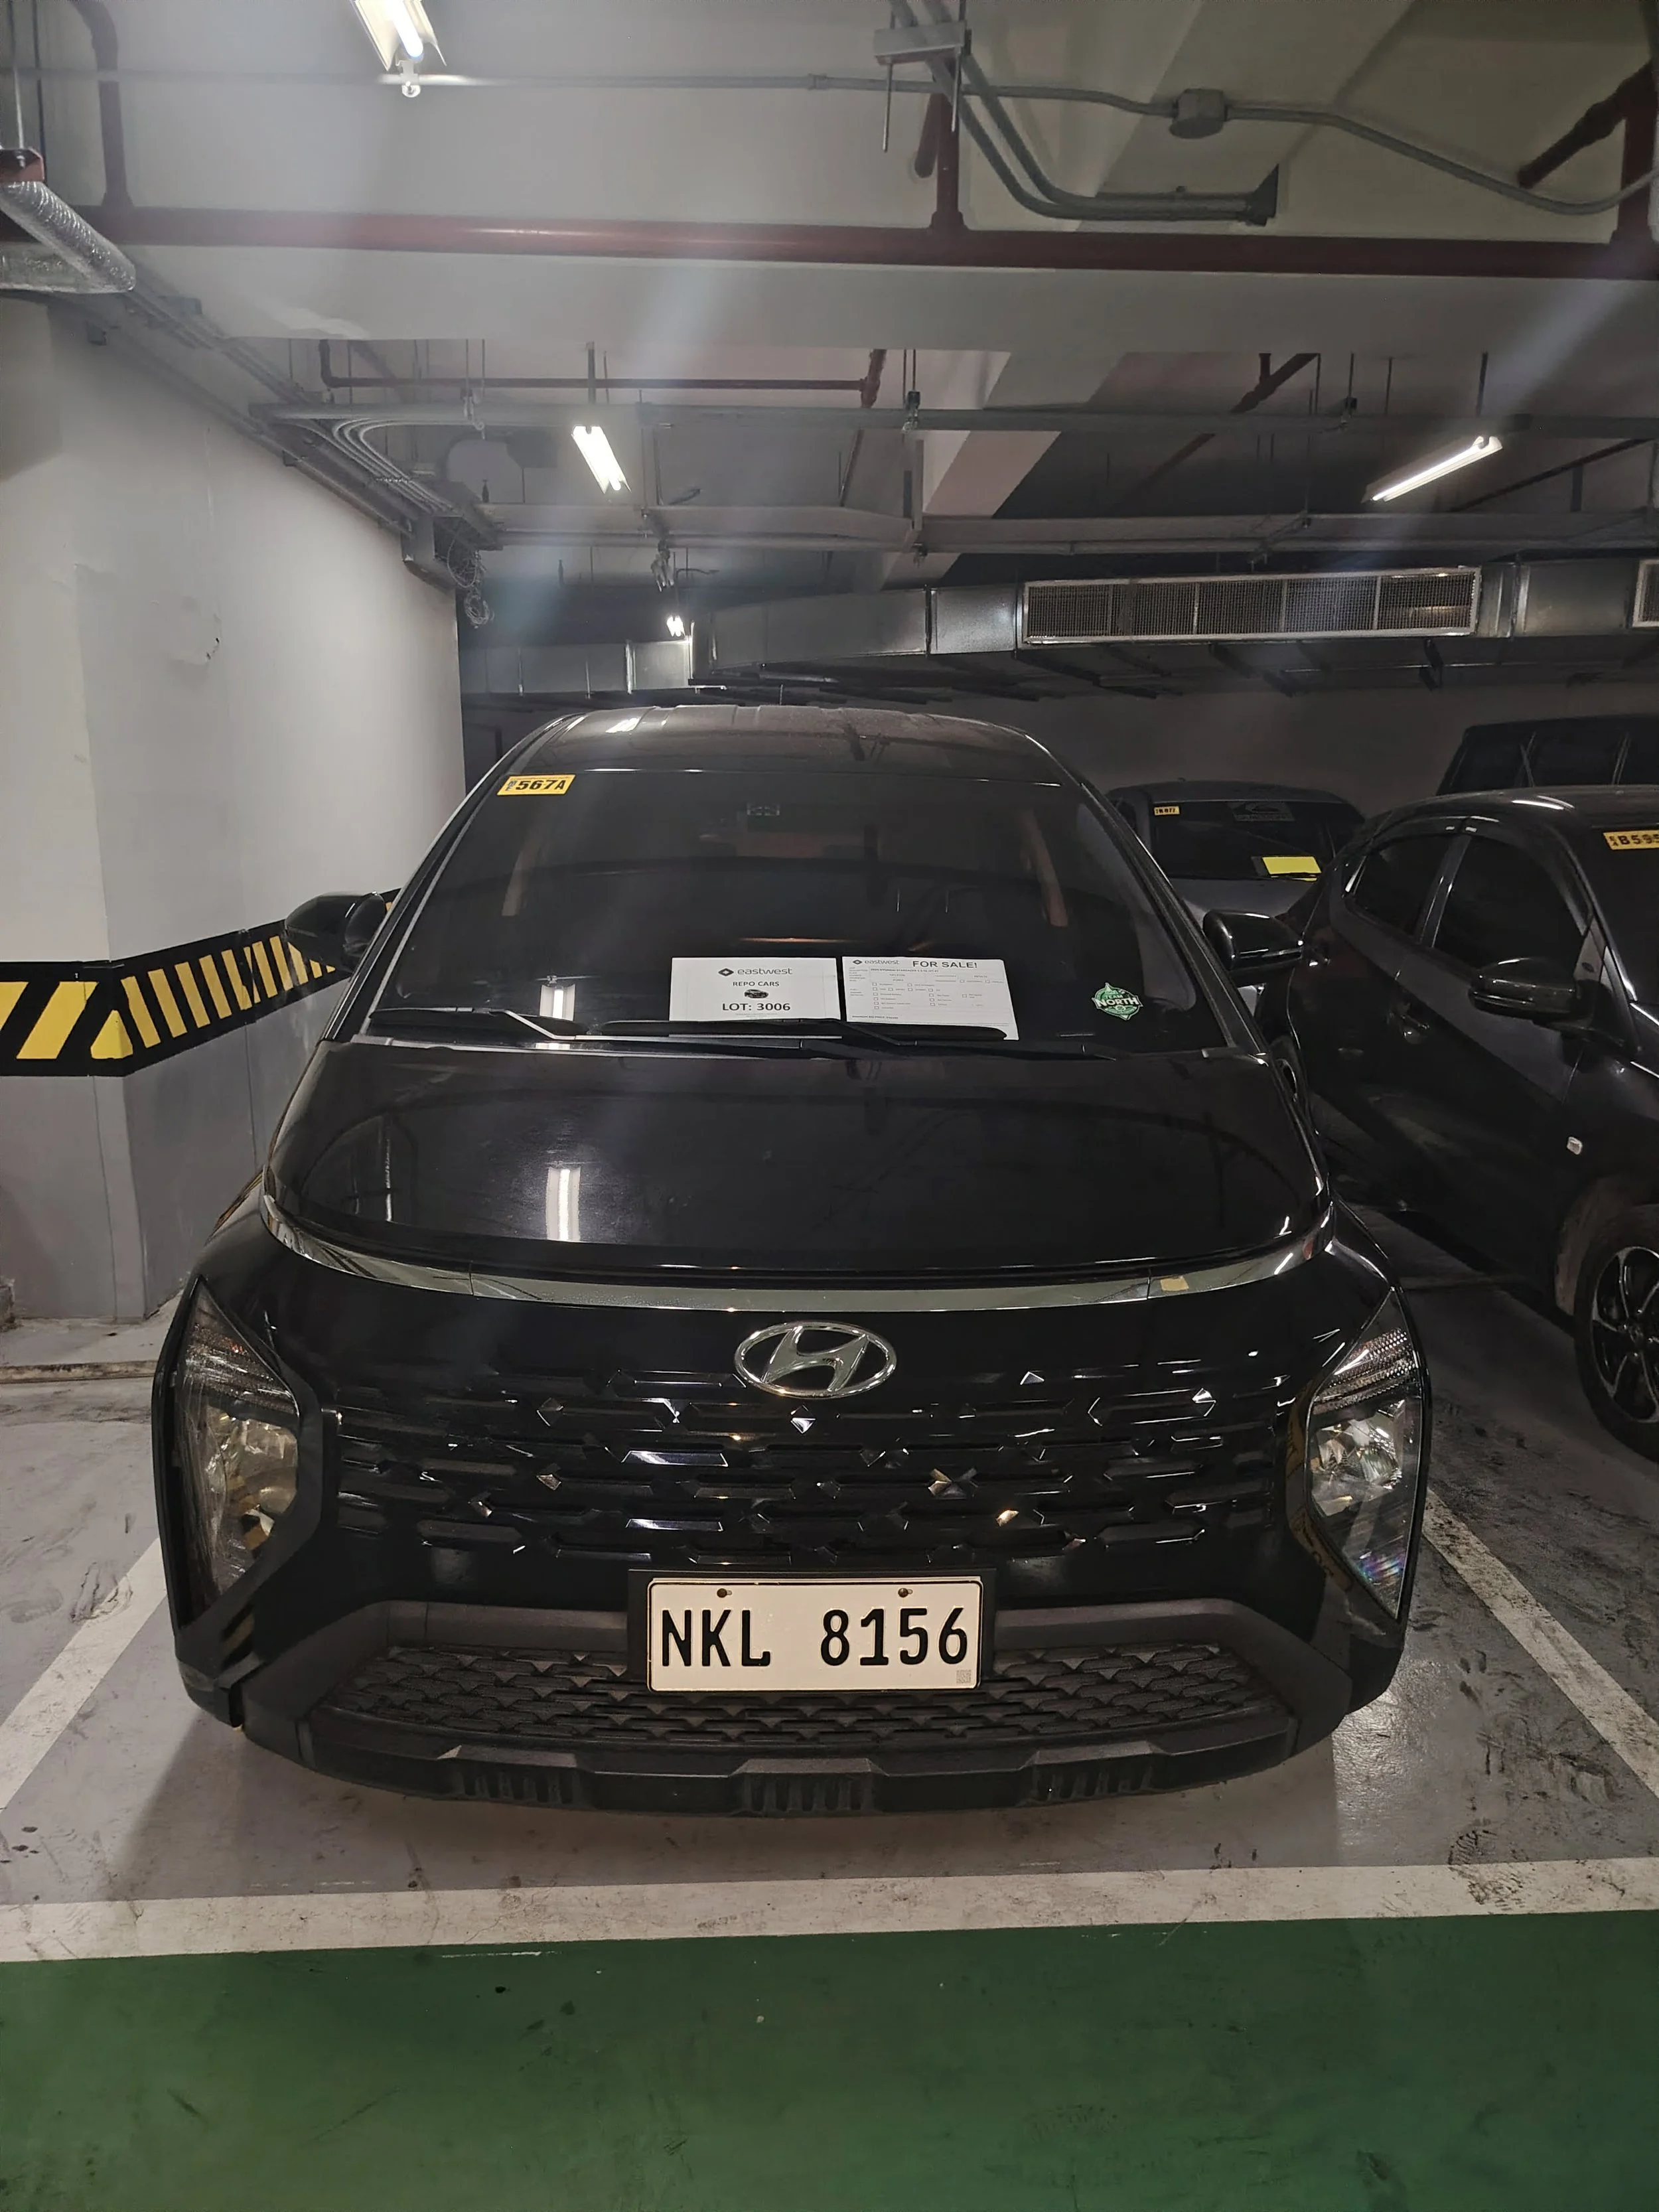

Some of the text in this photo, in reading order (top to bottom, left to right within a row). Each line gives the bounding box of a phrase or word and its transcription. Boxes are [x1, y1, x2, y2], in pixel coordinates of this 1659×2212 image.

[516, 779, 566, 790] 567A
[1095, 997, 1139, 1007] NORTH
[662, 1607, 968, 1667] NKL 8156
